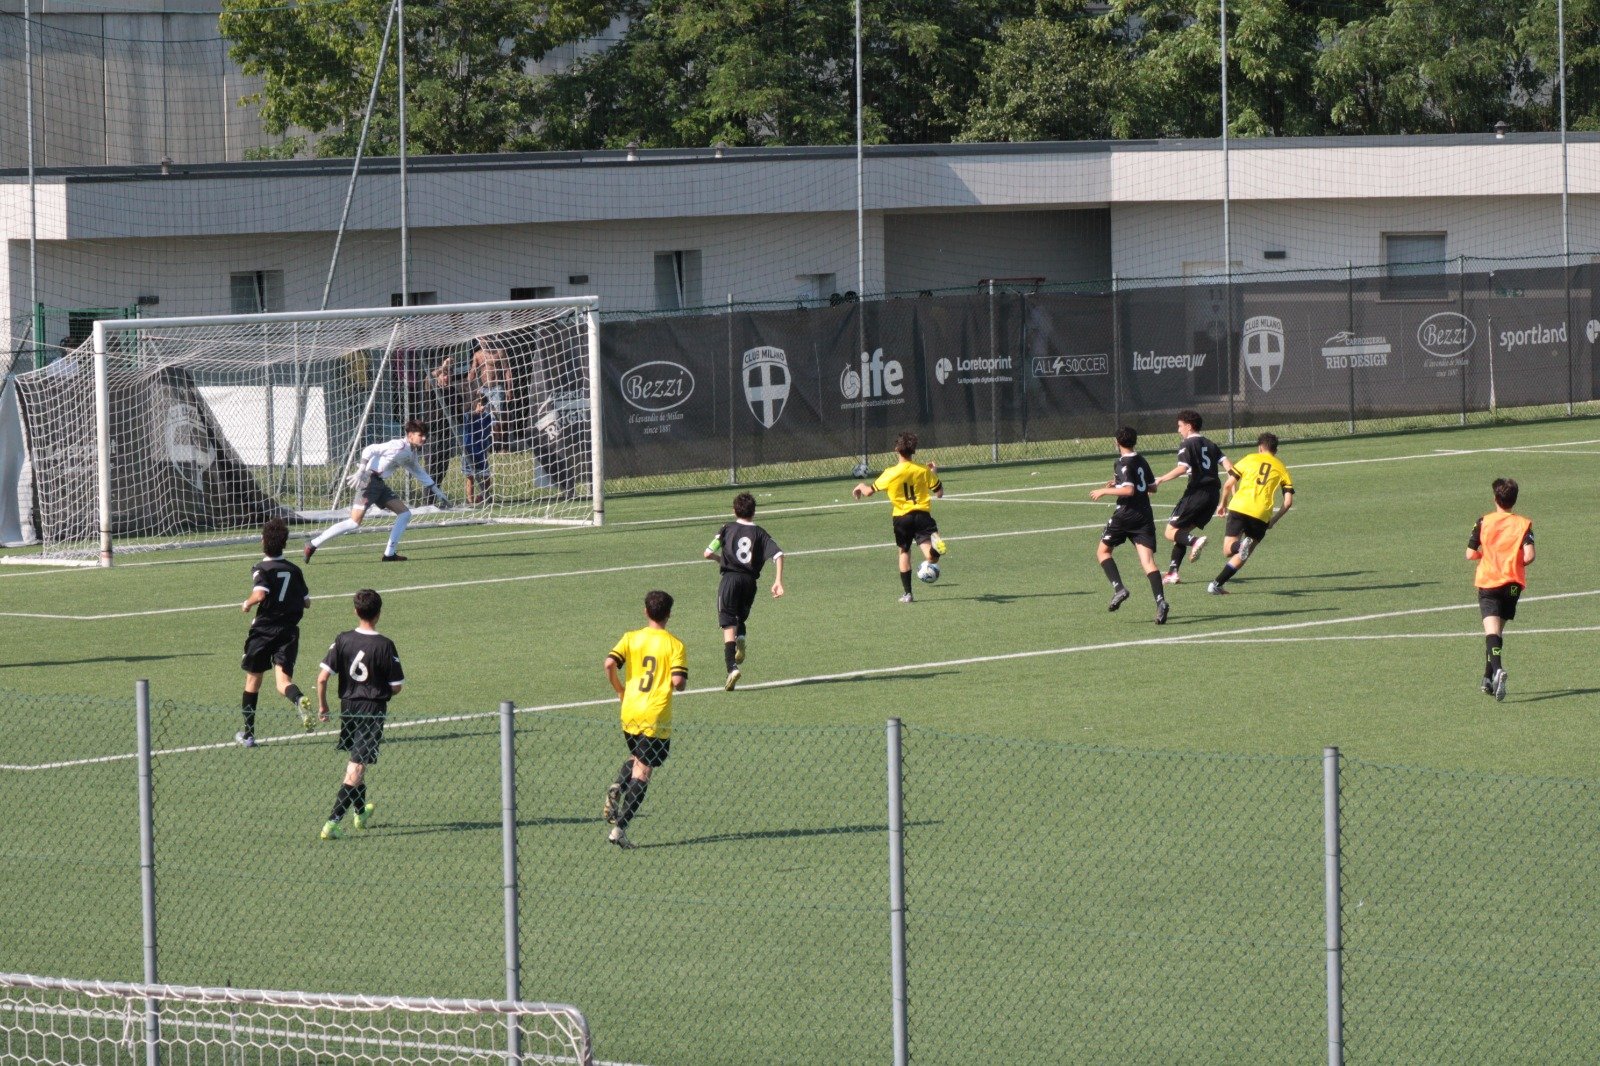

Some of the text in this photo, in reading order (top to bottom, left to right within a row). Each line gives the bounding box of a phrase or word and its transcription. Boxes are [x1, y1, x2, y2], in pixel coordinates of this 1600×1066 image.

[1423, 321, 1468, 346] Bezzi
[1500, 321, 1568, 352] sportland
[744, 349, 785, 364] CLUB MILANO
[956, 355, 1012, 374] Loretoprint
[1133, 351, 1198, 374] Italgreen
[1326, 354, 1387, 369] RHO DESIGN
[627, 370, 683, 400] Bezzi
[1201, 446, 1211, 470] 5
[1137, 466, 1147, 492] 3
[1256, 462, 1272, 486] 9
[736, 536, 753, 564] 8
[276, 571, 292, 602] 7
[349, 650, 369, 682] 6
[638, 655, 657, 693] 3
